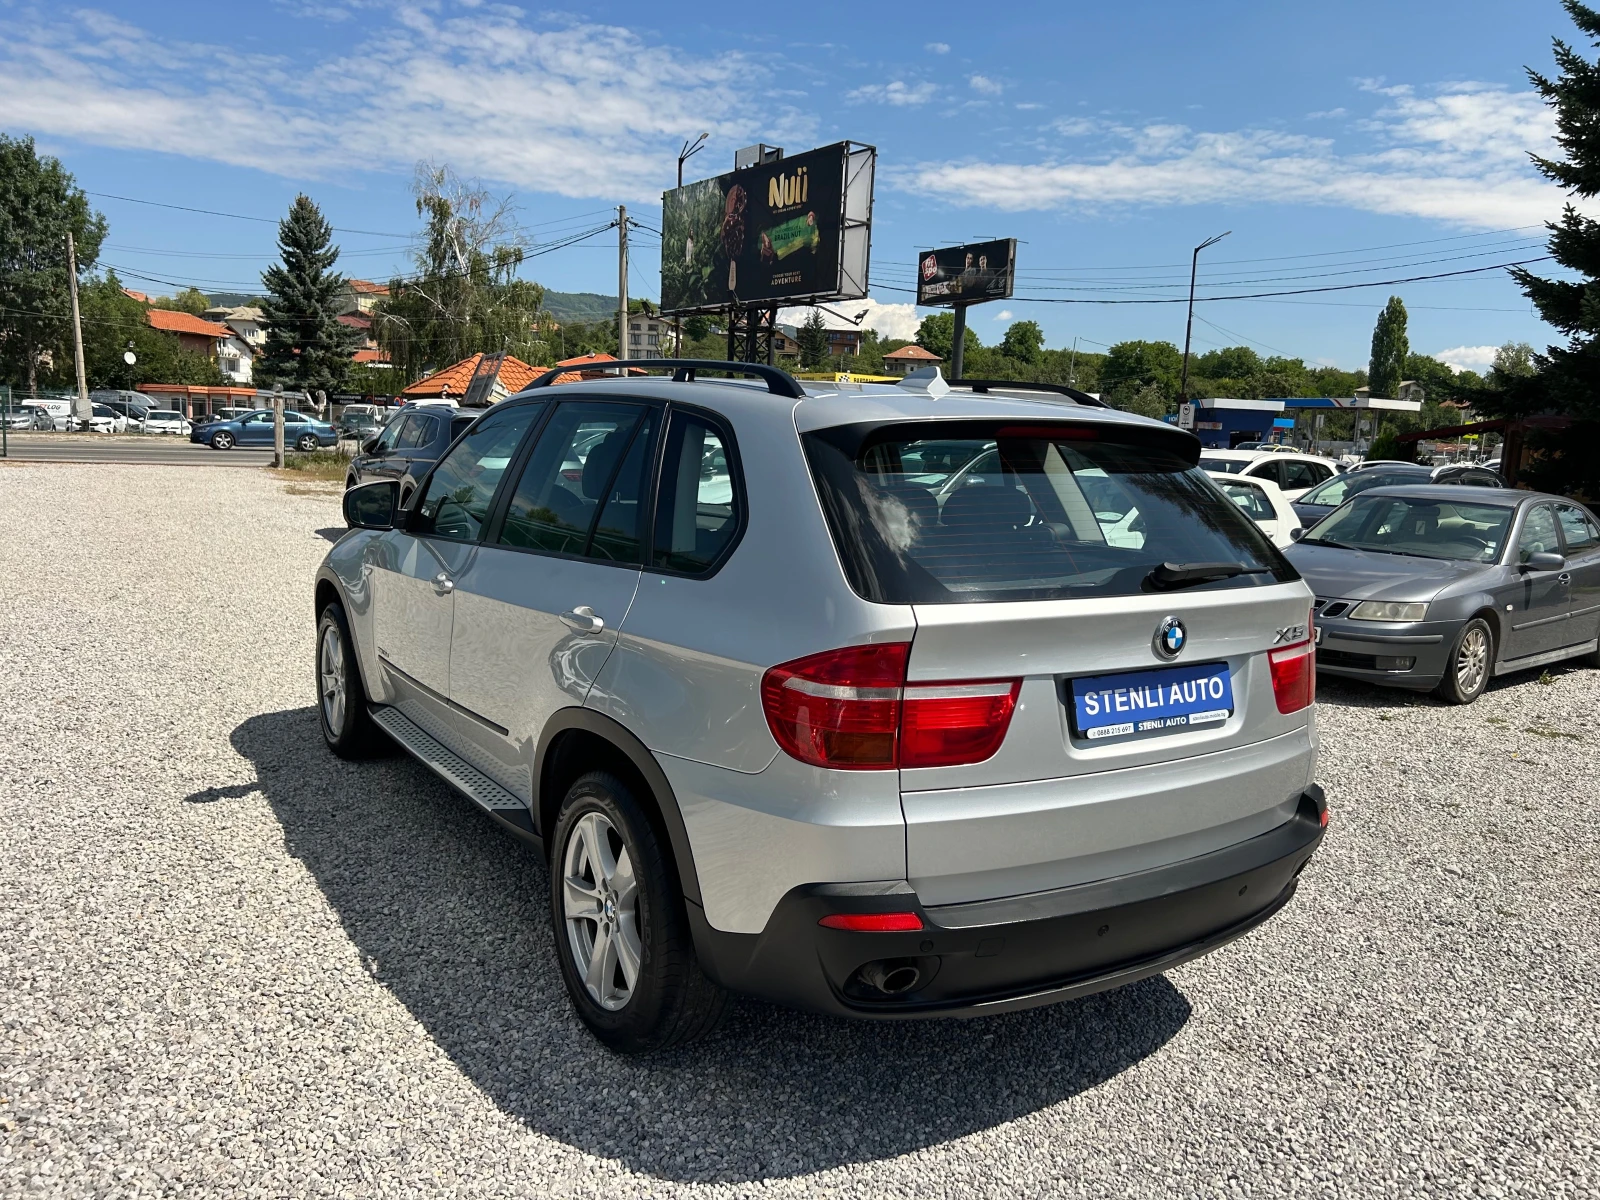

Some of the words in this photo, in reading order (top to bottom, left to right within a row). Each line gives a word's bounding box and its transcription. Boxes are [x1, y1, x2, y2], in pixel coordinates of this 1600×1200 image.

[771, 275, 802, 286] ADVENTURE
[1272, 625, 1303, 645] X5
[1084, 684, 1164, 716] STENLI
[1169, 677, 1224, 705] AUTO
[1096, 728, 1110, 736] 0888
[1111, 726, 1121, 734] 215
[1121, 725, 1131, 733] 697
[1138, 719, 1164, 731] STENLI
[1165, 717, 1187, 727] AUTO
